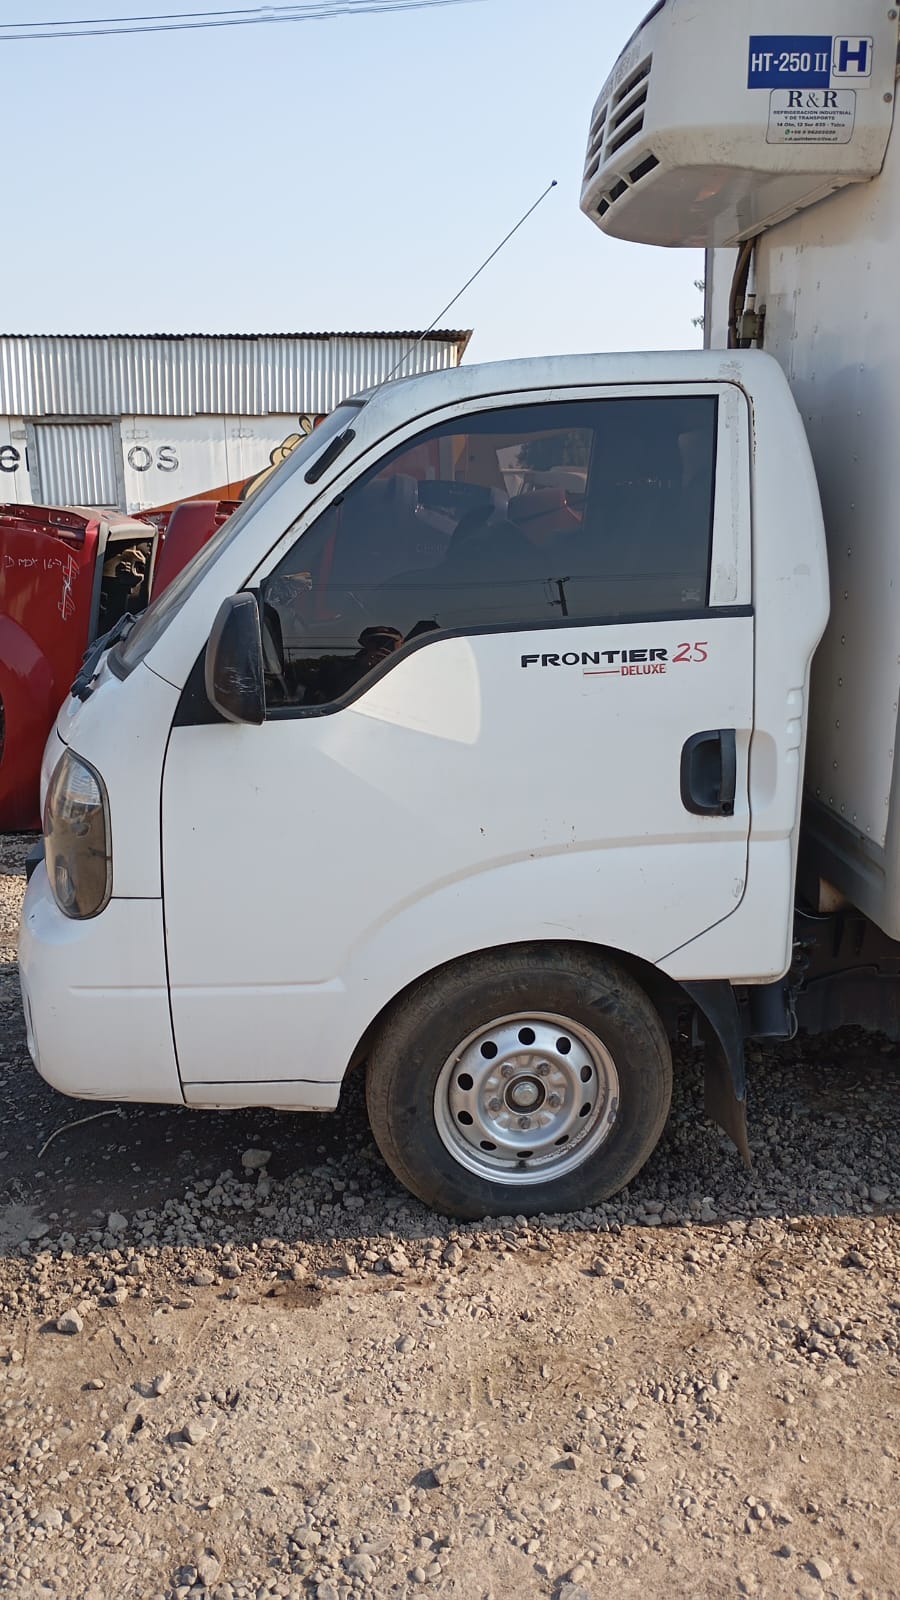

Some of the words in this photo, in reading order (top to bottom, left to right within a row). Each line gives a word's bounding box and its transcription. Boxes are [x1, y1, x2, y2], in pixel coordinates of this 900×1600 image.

[751, 52, 810, 71] HT-250
[520, 648, 668, 668] FRONTIER
[621, 664, 666, 676] DELUXE
